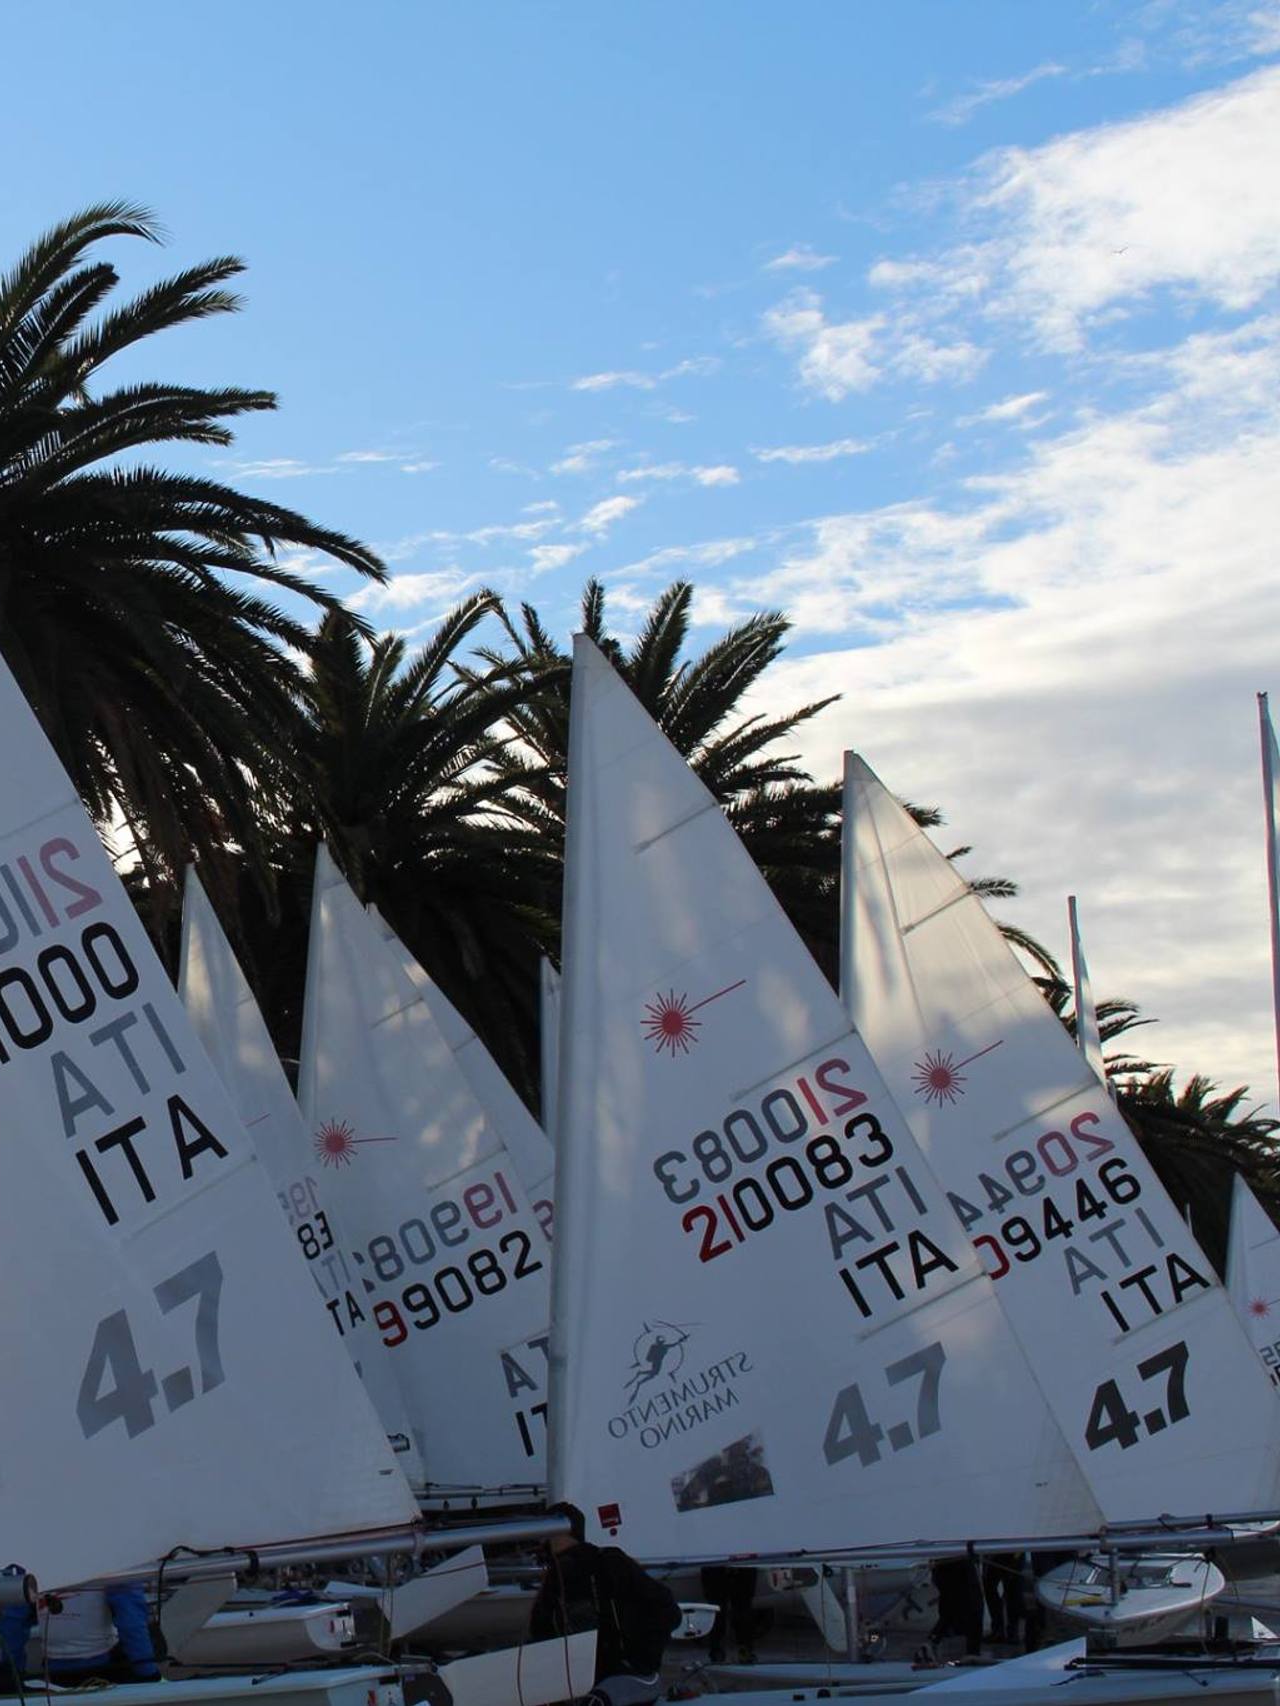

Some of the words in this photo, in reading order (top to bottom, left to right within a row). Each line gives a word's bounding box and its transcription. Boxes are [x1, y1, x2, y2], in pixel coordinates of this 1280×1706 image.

[76, 1094, 228, 1226] ITA
[682, 1112, 894, 1264] 210083
[839, 1230, 959, 1318] ITA
[1101, 1252, 1212, 1334] ITA
[76, 1250, 225, 1440] 4.7
[823, 1341, 947, 1469] 4.7
[1084, 1340, 1191, 1452] 4.7
